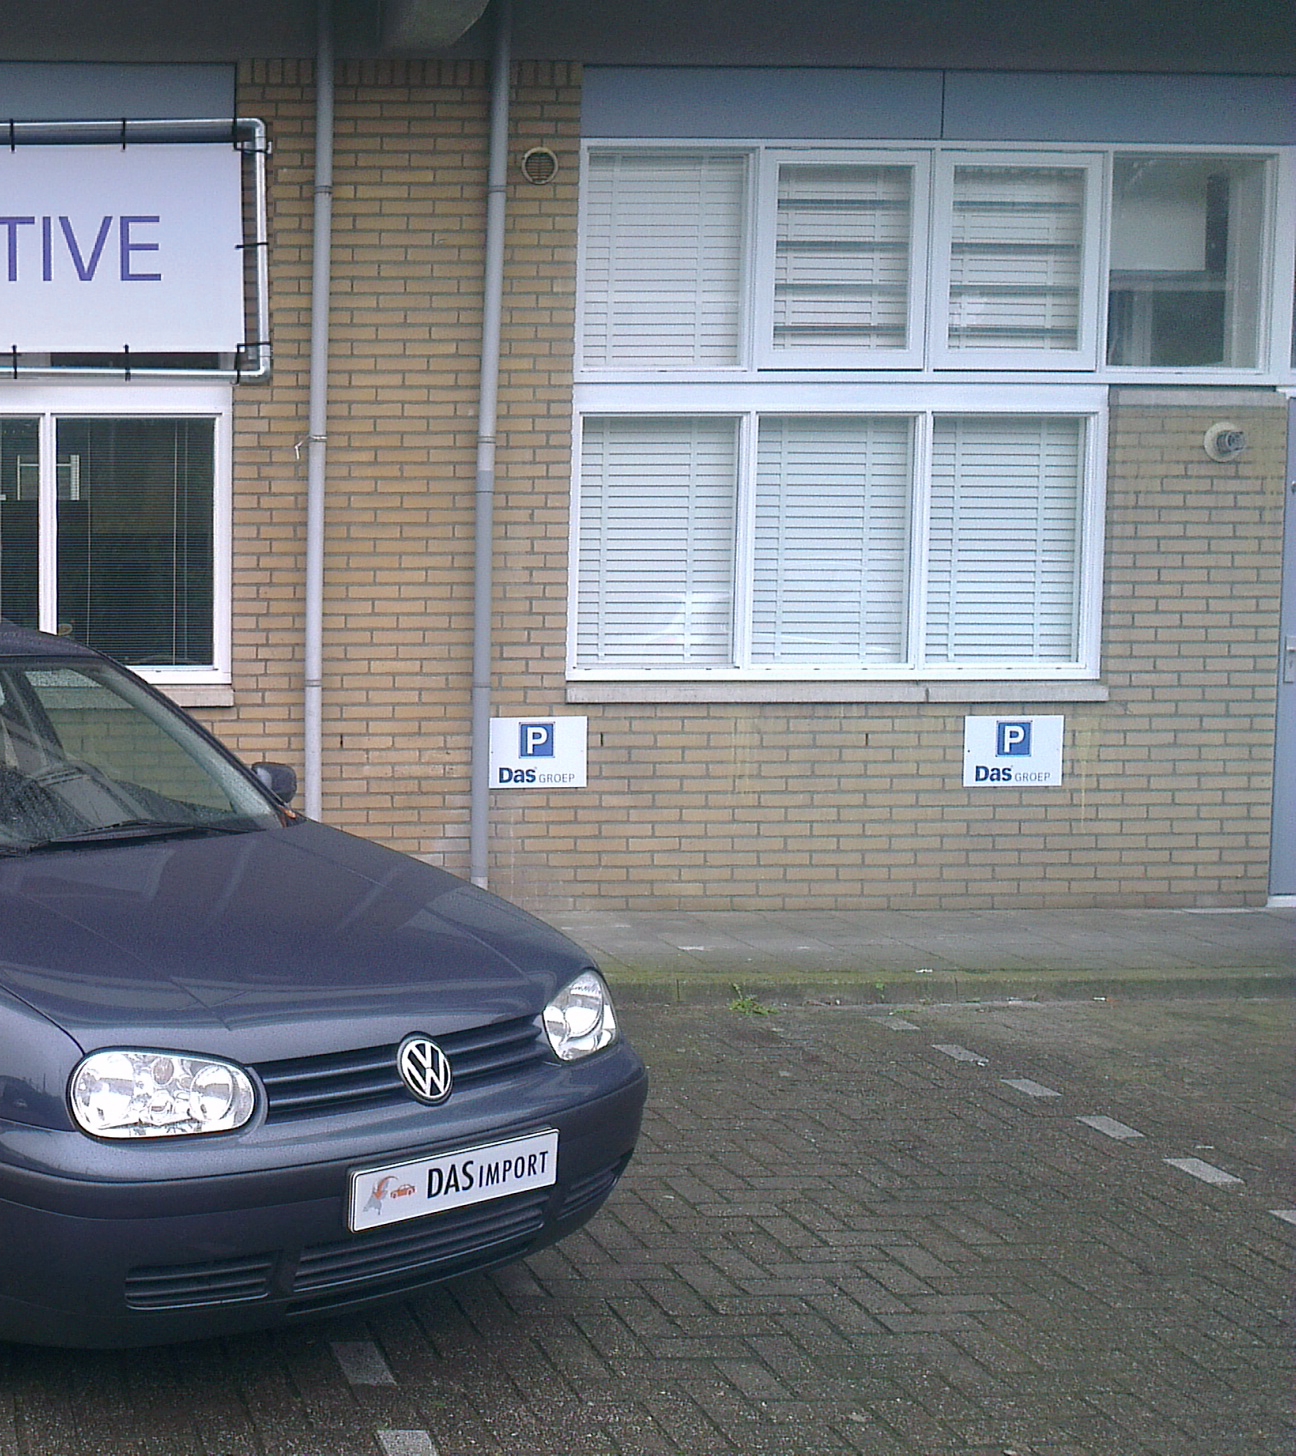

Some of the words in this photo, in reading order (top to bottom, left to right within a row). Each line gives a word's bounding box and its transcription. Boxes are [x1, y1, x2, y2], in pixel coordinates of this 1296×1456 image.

[526, 727, 547, 754] P
[1004, 726, 1025, 753] P
[499, 767, 536, 783] Das
[539, 774, 575, 783] GROEP
[975, 766, 1012, 782] Das
[1015, 773, 1051, 782] GROEP
[427, 1160, 474, 1198] DAS
[479, 1151, 548, 1188] IMPORT
